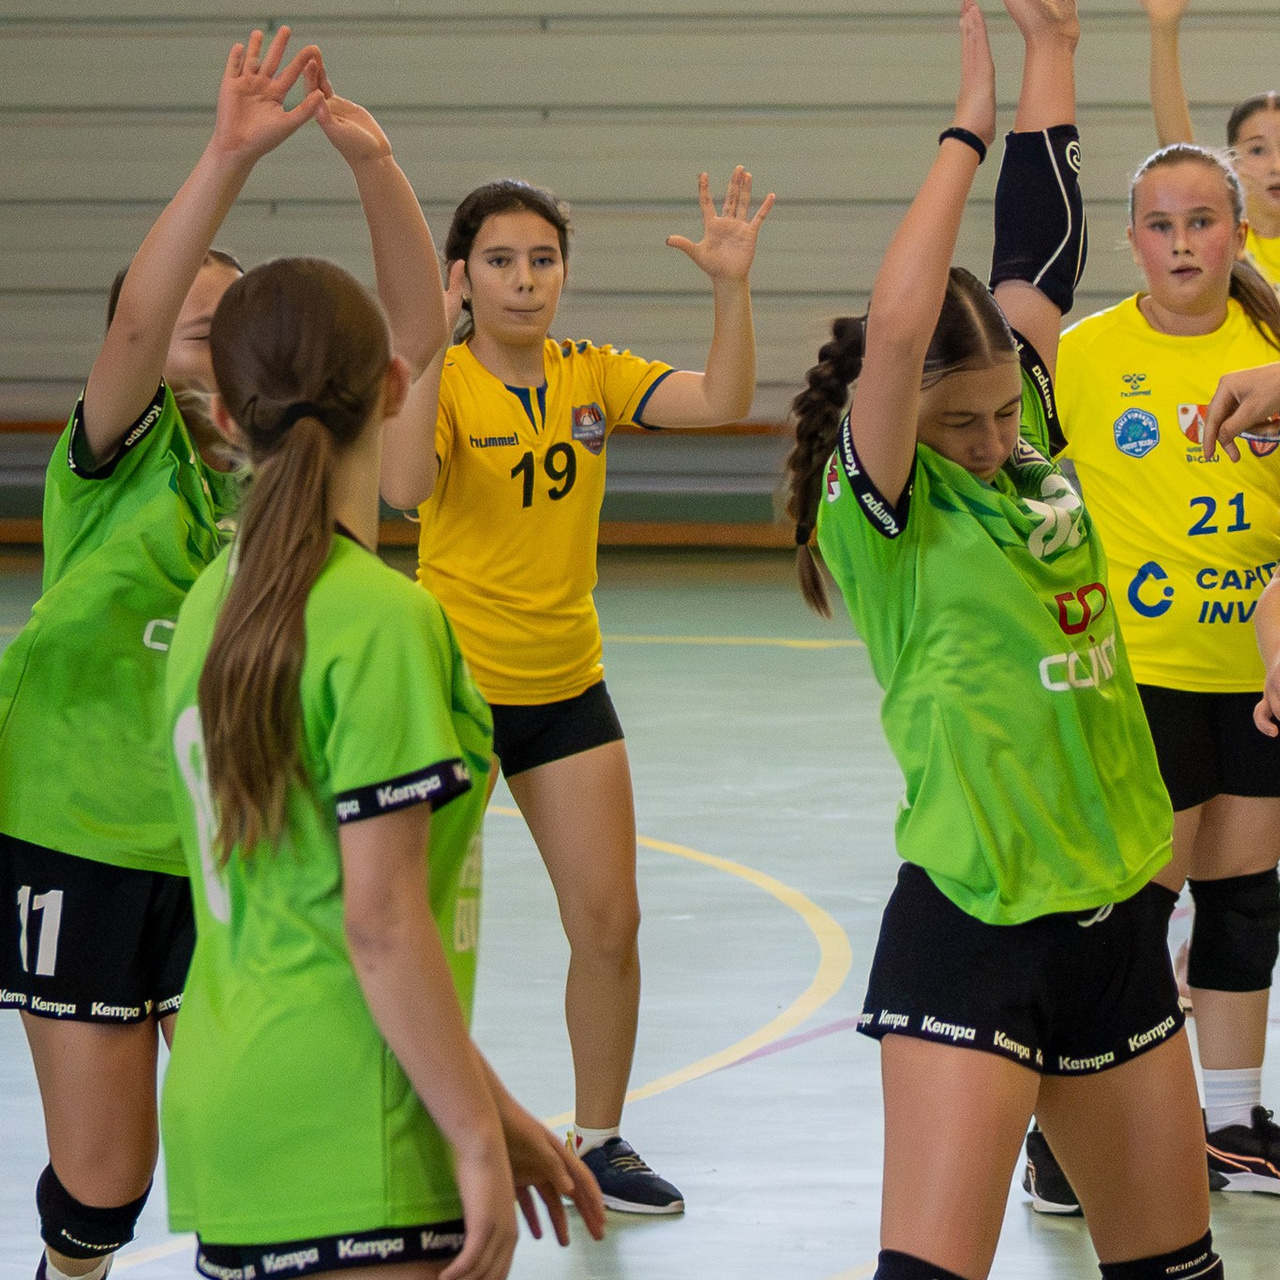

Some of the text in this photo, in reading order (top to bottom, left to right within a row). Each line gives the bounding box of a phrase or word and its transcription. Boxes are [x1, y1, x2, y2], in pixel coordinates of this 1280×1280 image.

[124, 405, 162, 447] Kempa
[469, 431, 520, 448] hummel
[511, 446, 577, 508] 19
[861, 493, 899, 535] Kempa
[1188, 492, 1251, 536] 21
[1198, 601, 1257, 624] INV
[376, 775, 442, 807] Kempa
[17, 885, 64, 977] 11
[31, 995, 76, 1017] Kempa
[90, 1001, 140, 1020] Kempa
[878, 1009, 909, 1027] Kempa
[920, 1015, 976, 1041] Kempa
[993, 1030, 1031, 1060] Kempa
[1058, 1050, 1115, 1071] Kempa
[1127, 1015, 1176, 1052] Kempa
[337, 1237, 405, 1259] Kempa
